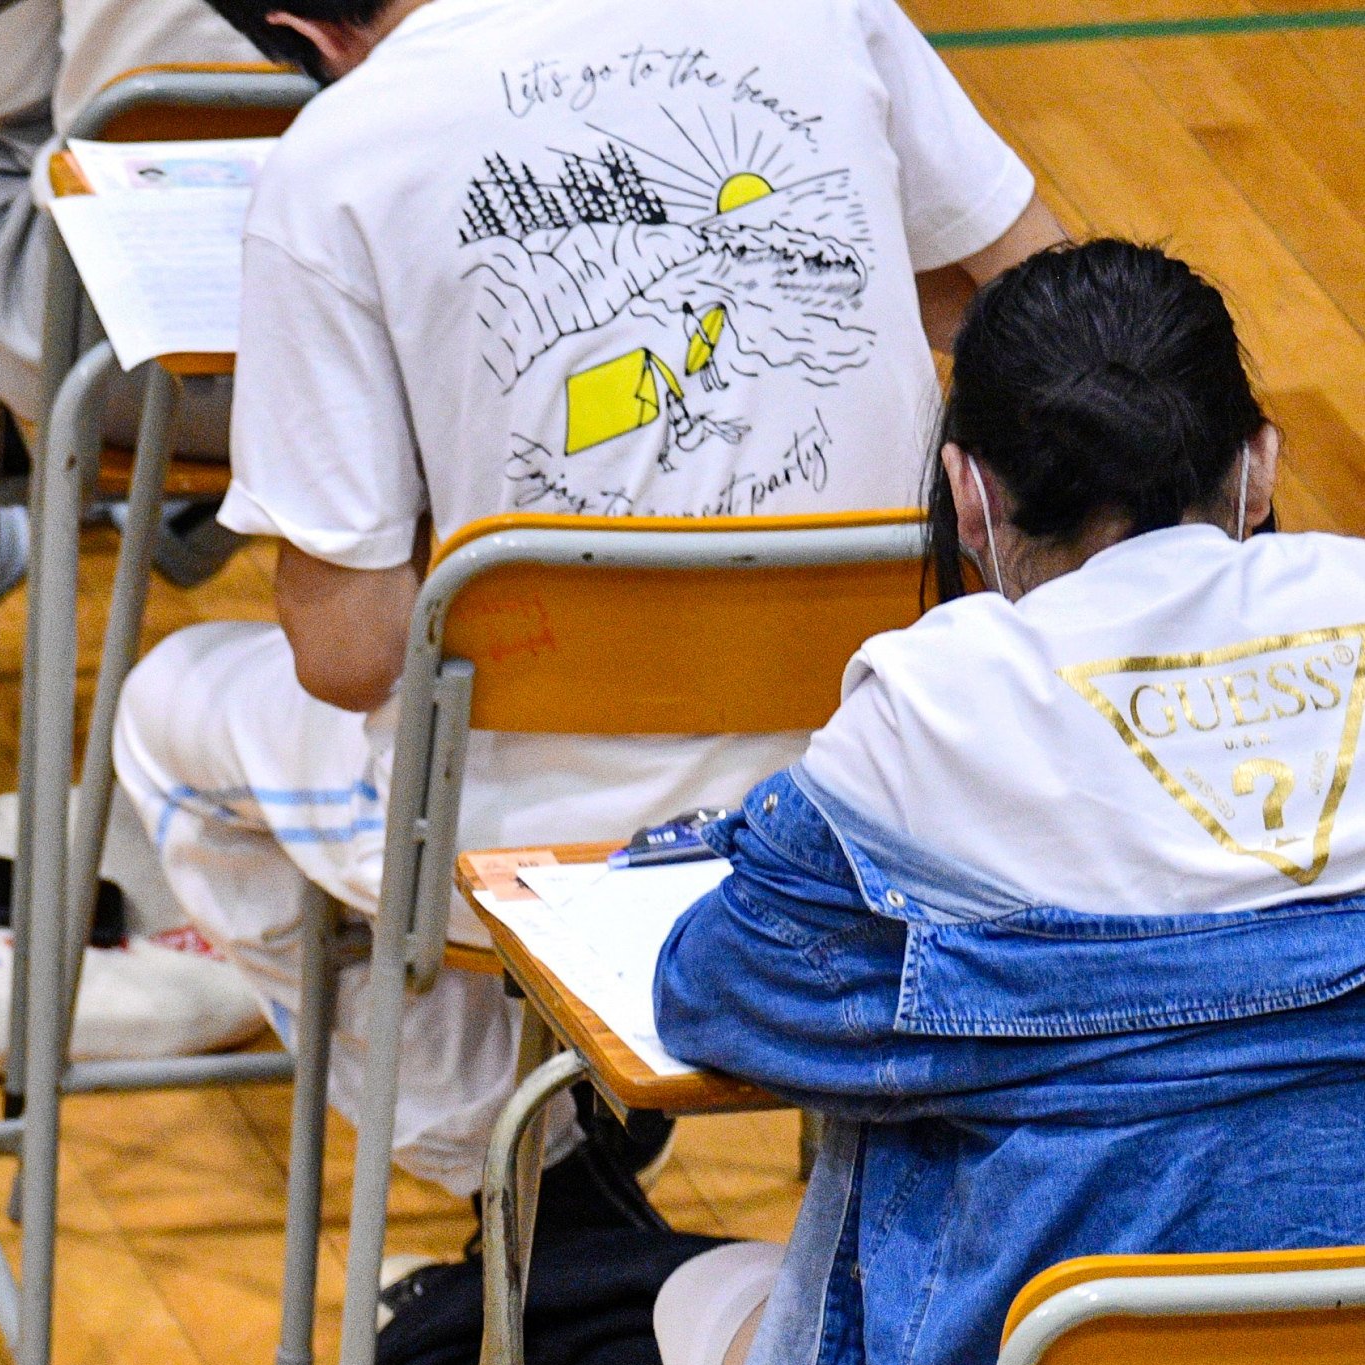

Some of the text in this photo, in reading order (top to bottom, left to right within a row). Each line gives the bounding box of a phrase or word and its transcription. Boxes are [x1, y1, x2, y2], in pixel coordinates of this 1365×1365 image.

[500, 60, 567, 119] Let's
[570, 60, 616, 113] go
[619, 43, 658, 88] to
[661, 46, 726, 90] the
[504, 431, 596, 514] Enjoy
[749, 407, 835, 515] party!
[1130, 654, 1342, 738] GUESS
